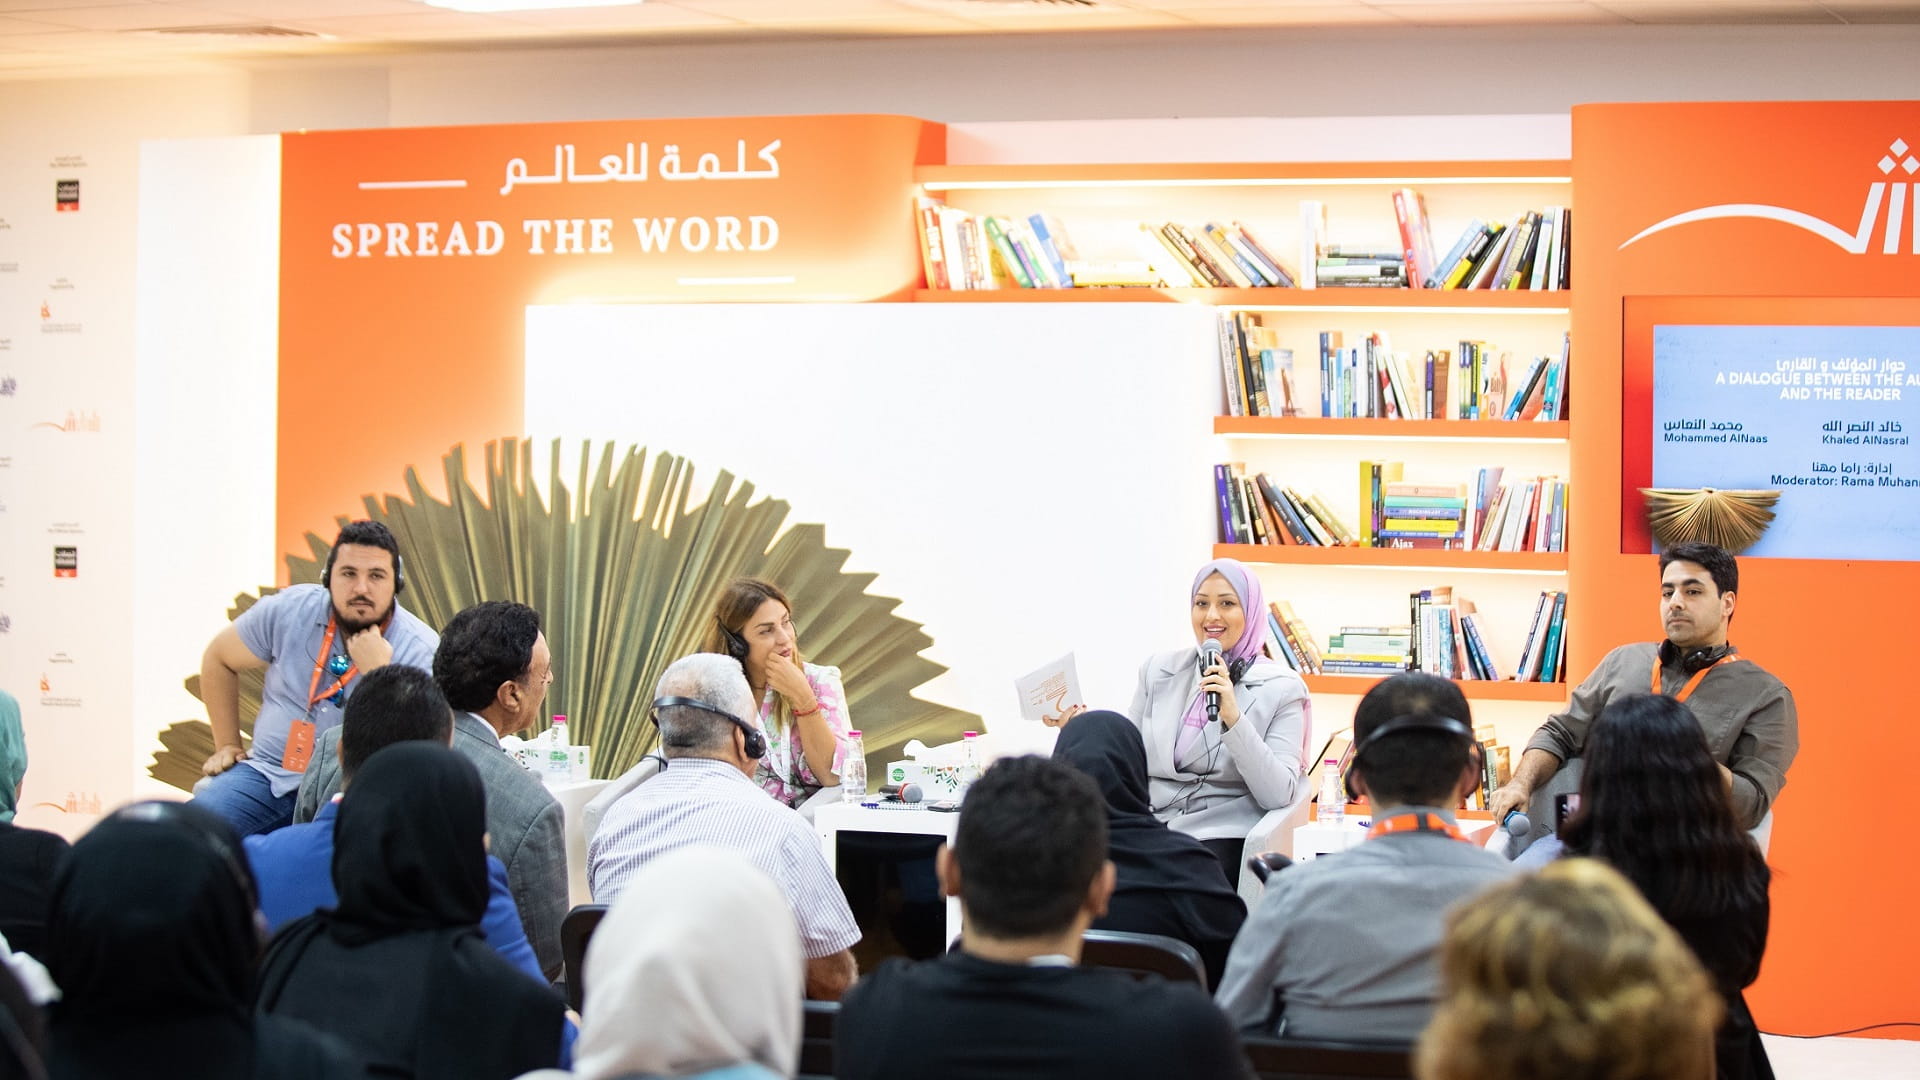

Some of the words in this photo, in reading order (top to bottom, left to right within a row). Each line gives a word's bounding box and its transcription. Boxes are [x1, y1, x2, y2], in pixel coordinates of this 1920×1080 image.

[659, 139, 782, 181] كلمة
[499, 142, 649, 196] للعالم
[331, 220, 505, 258] SPREAD
[523, 218, 614, 254] THE
[632, 215, 781, 253] WORD
[1820, 359, 1829, 373] و
[1880, 358, 1906, 374] حوار
[1715, 372, 1726, 385] A
[1729, 372, 1801, 385] DIALOGUE
[1804, 373, 1871, 386] BETWEEN
[1874, 373, 1903, 386] THE
[1779, 387, 1810, 400] AND
[1814, 387, 1842, 400] THE
[1846, 388, 1901, 400] READER
[1663, 419, 1706, 431] النعاس
[1710, 422, 1743, 431] محمد
[1822, 420, 1842, 432] الله
[1846, 420, 1875, 434] النصر
[1878, 421, 1902, 432] خالد
[1664, 433, 1727, 443] Mohammed
[1729, 433, 1768, 443] AlNaas
[1822, 434, 1860, 445] Khaled
[1862, 435, 1909, 446] AlNasral
[1812, 461, 1837, 473] مهنا
[1841, 462, 1861, 475] راما
[1771, 474, 1838, 486] Moderator:
[1841, 475, 1875, 487] Rama
[1391, 537, 1415, 549] Ajax
